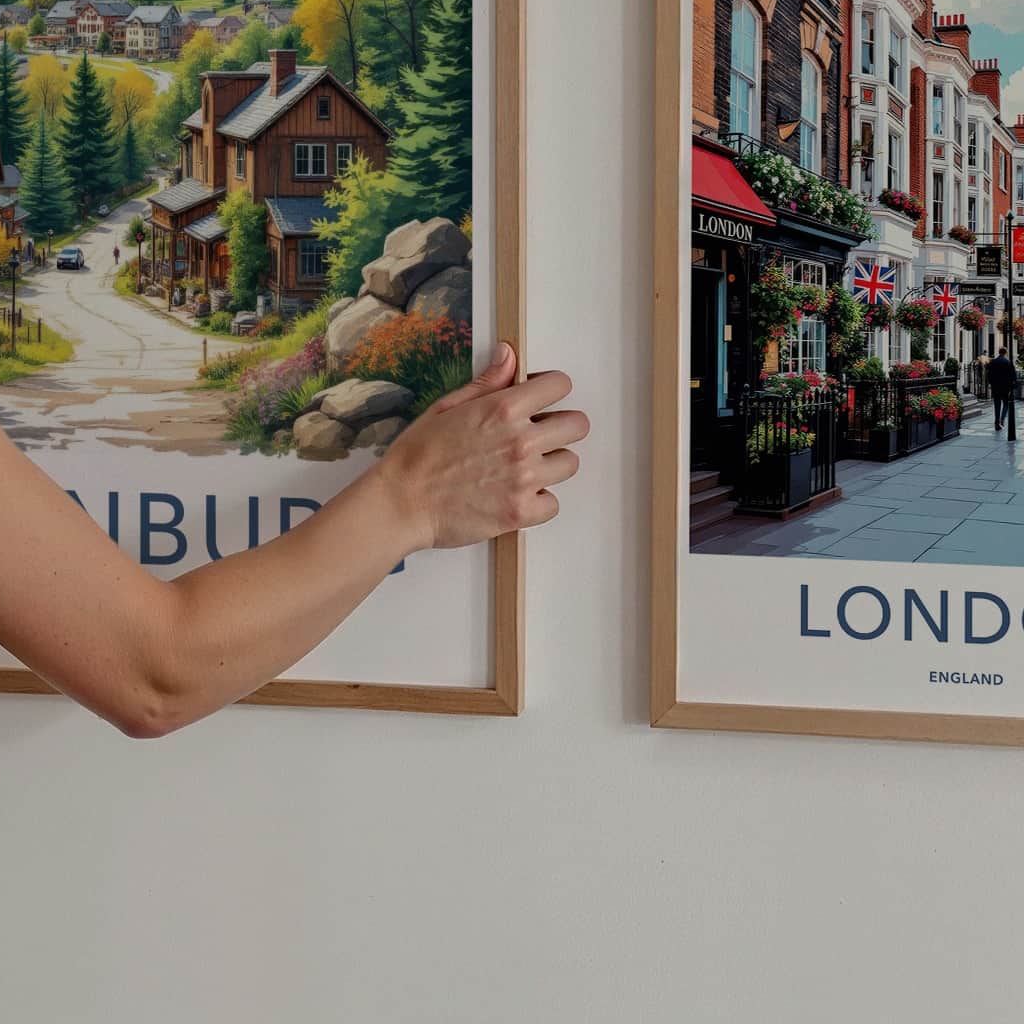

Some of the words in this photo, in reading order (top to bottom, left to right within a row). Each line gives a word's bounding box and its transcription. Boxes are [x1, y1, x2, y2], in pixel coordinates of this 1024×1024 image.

[699, 213, 753, 242] LONDON
[800, 584, 1024, 645] LOND
[929, 671, 1004, 686] ENGLAND
